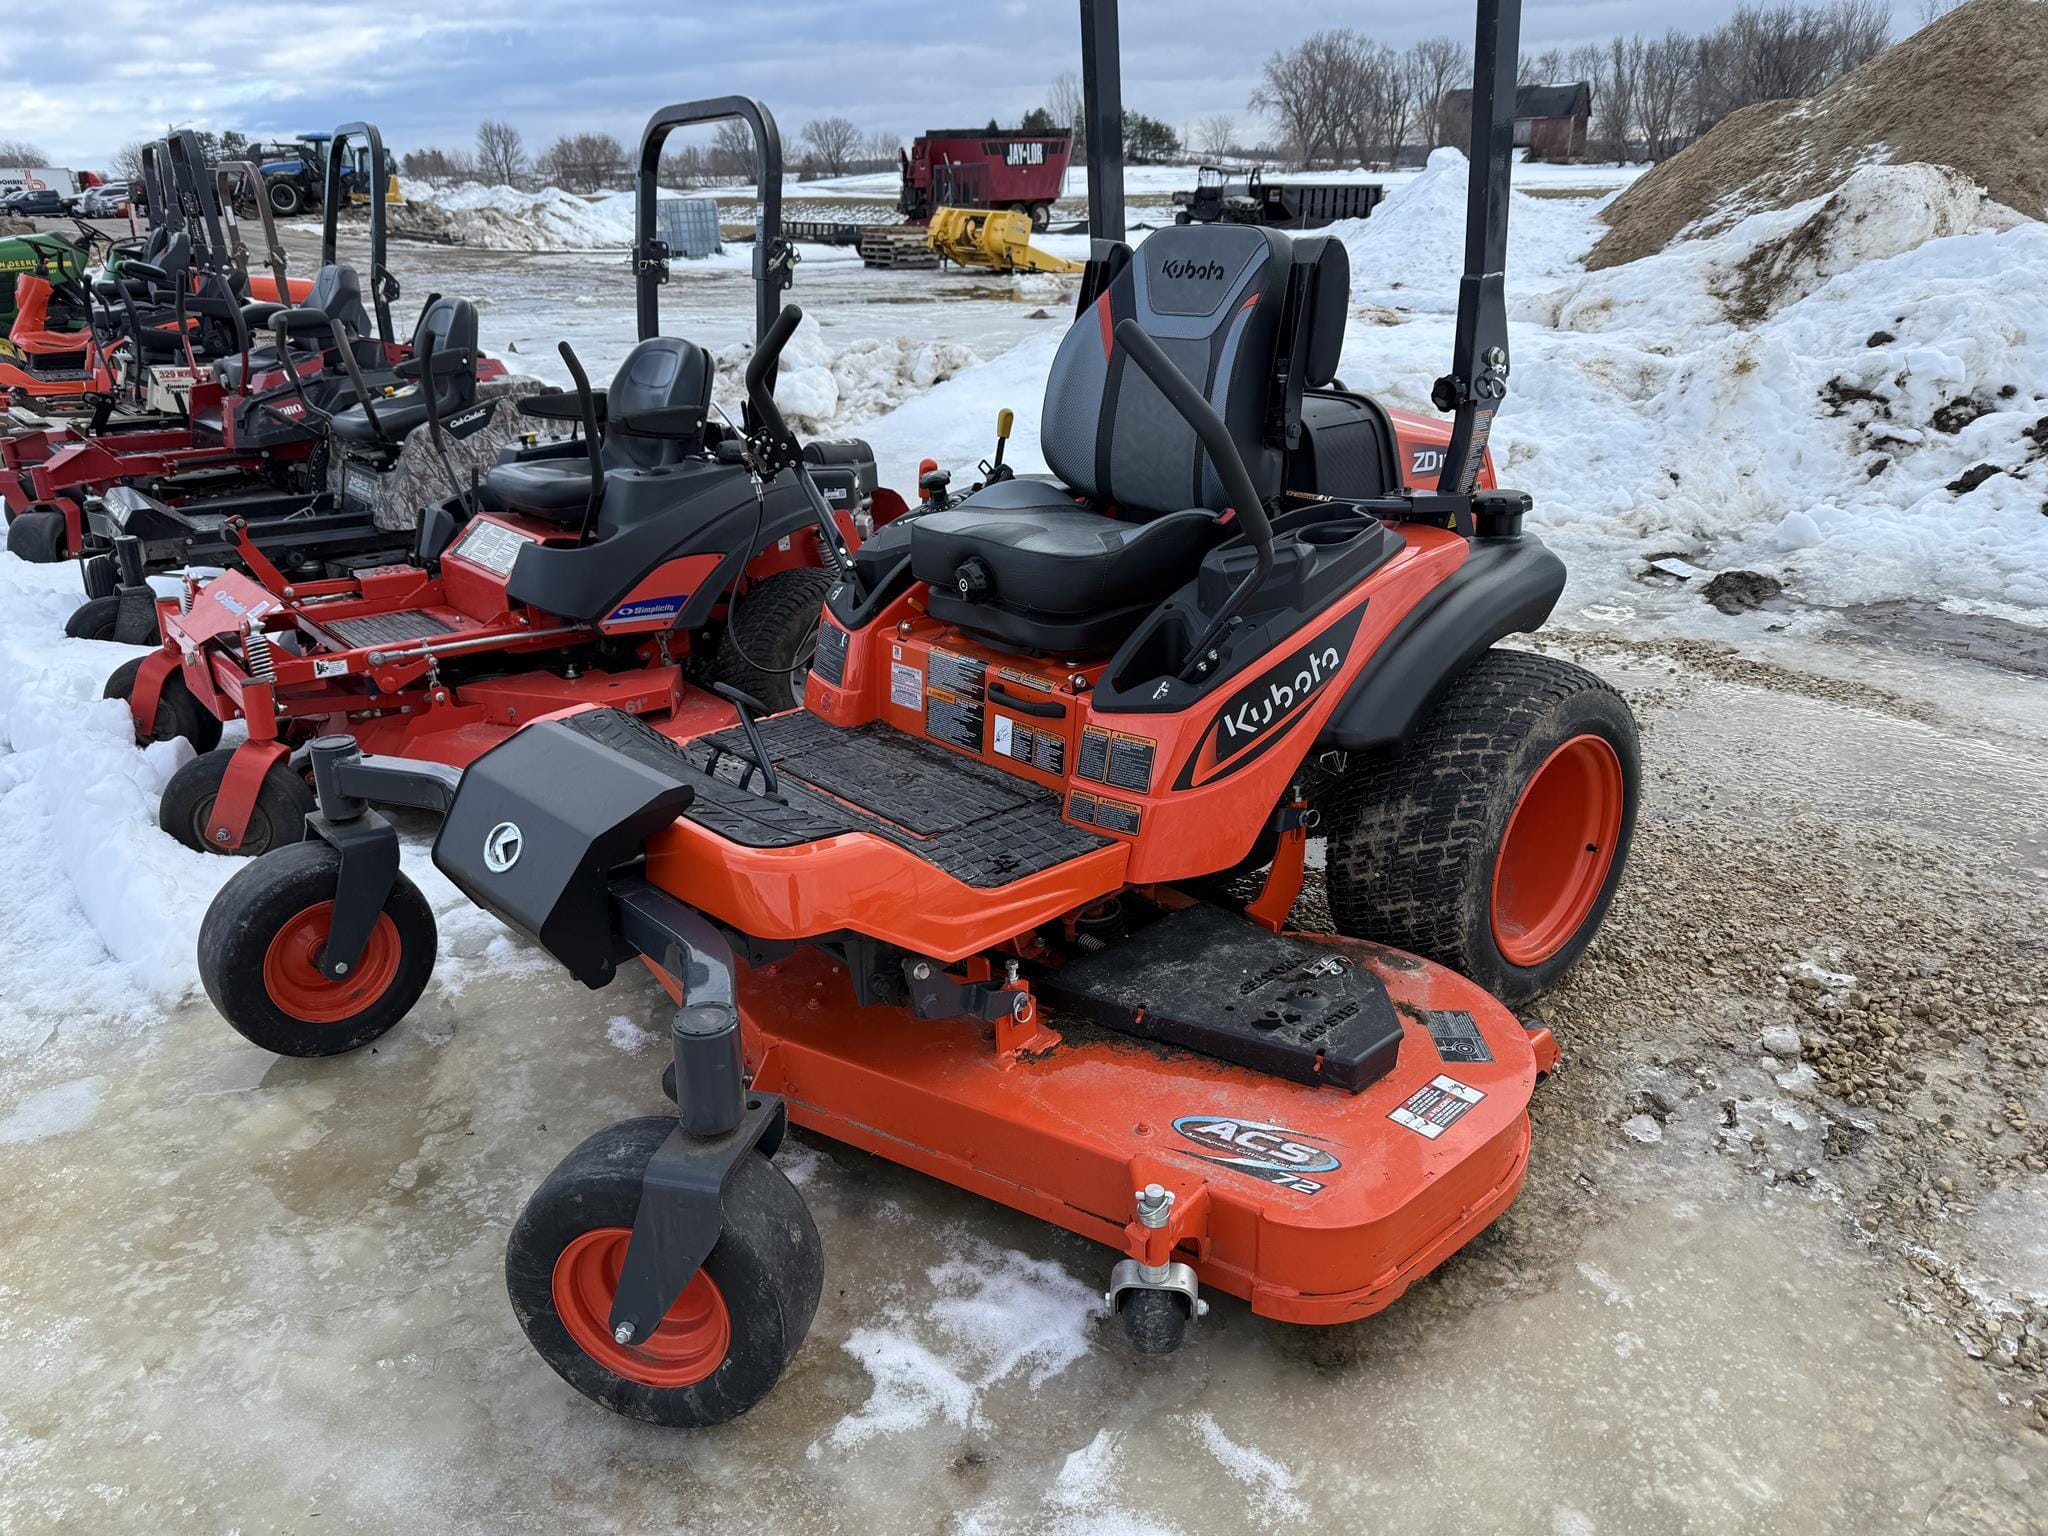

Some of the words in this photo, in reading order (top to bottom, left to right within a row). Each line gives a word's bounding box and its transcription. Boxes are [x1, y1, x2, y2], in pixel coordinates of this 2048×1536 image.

[1161, 259, 1225, 280] Kubota
[279, 402, 304, 416] ORO
[634, 603, 674, 615] Simplicity
[1224, 647, 1340, 737] Kubota
[1300, 1024, 1327, 1041] NO
[1192, 1121, 1321, 1163] ACS
[1271, 1172, 1322, 1195] 72
